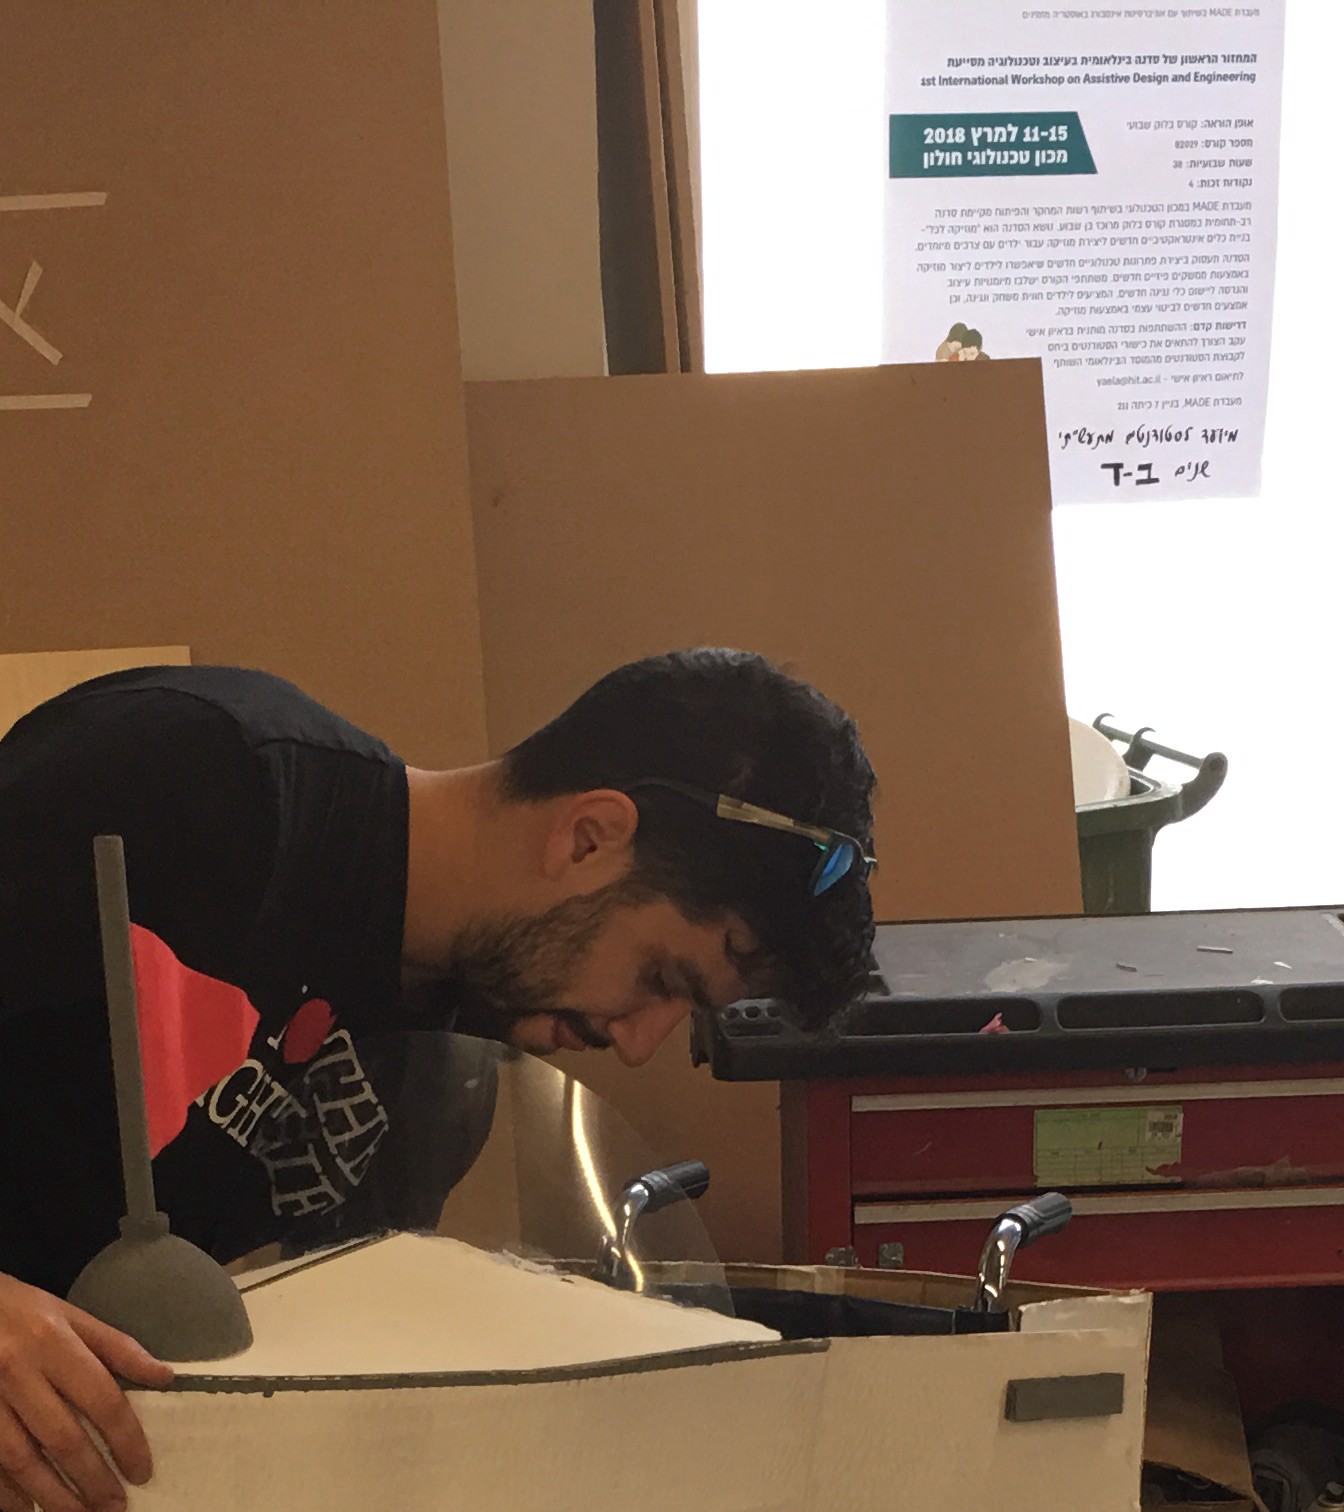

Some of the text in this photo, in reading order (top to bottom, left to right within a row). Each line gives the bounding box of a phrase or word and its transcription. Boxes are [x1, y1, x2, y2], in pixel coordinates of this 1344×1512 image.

[946, 53, 1257, 67] המחזור הראשון של סדנה בינלאומית בעיצוב וטכנולוגיה מסייעת
[920, 70, 1256, 86] 1st International Workshop on Assistive Design and Engineering
[1153, 119, 1174, 130] בלוק
[1176, 119, 1197, 130] קורס
[1234, 118, 1254, 128] אופן
[923, 123, 1068, 146] 11-15 למרץ 2018
[1228, 138, 1253, 147] מספר
[922, 147, 1068, 168] מכון טכנולוגי חולון
[1228, 158, 1252, 167] שעות
[1222, 178, 1252, 188] נקודות
[1065, 205, 1089, 214] רשות
[1124, 202, 1165, 213] הטכנולוגי
[1166, 202, 1190, 213] במכון
[1192, 200, 1220, 211] MADE
[1221, 201, 1252, 211] מעבדת
[934, 208, 957, 217] סדנה
[960, 208, 992, 218] מקיימת
[994, 207, 1029, 216] והפיתוח
[1032, 206, 1063, 216] המחקר
[982, 217, 1252, 232] רב-תחומית במסגרת קורס בלוק מרוכז נושא הסדנה הוא
[1078, 236, 1107, 247] ליצירת
[1109, 236, 1139, 246] חדשים
[1140, 234, 1205, 246] אינטראקטיביים
[1206, 233, 1227, 243] כלים
[1228, 233, 1251, 242] בניית
[953, 241, 980, 250] צרכים
[982, 240, 995, 249] עם
[997, 238, 1021, 249] ילדים
[1024, 239, 1044, 248] עבור
[1046, 238, 1076, 248] מוזיקה
[916, 253, 1250, 273] הסדנה תעסוק ביצירת פתרונות טכנולוגיים חדשים שיאפשרו לילדים ליצור מוזיקה
[1070, 273, 1108, 283] משתתפי
[1143, 272, 1169, 281] פיזיים
[1171, 270, 1207, 281] ממשקים
[1209, 269, 1249, 279] באמצעות
[946, 278, 971, 287] עיצוב
[973, 276, 1011, 286] מיומנויות
[1013, 275, 1039, 285] ישלבו
[1041, 275, 1069, 285] הקורס
[949, 285, 1248, 304] והנדסה ליישום כלי נגינה המציעים לילדים משחק וכן
[1089, 301, 1248, 315] אמצעים חדשים לביטוי עצמי באמצעות
[1025, 321, 1247, 336] דרישות קדם: ההשתתפות בסדנה מותנית בראיון אישי
[1047, 336, 1246, 352] עקב הצורך להתאים את כישורי הסטודנטים ביחס
[1084, 351, 1245, 366] לקבוצת הסטודנטים מהמוסד הבינלאומי
[1170, 374, 1190, 383] אישי
[1192, 373, 1212, 383] ראיון
[1214, 371, 1244, 381] לתיאום
[1131, 397, 1242, 409] מעבדת בניין כיתה
[1201, 428, 1239, 445] מיועד
[1101, 460, 1211, 487] שנים ב-ד
